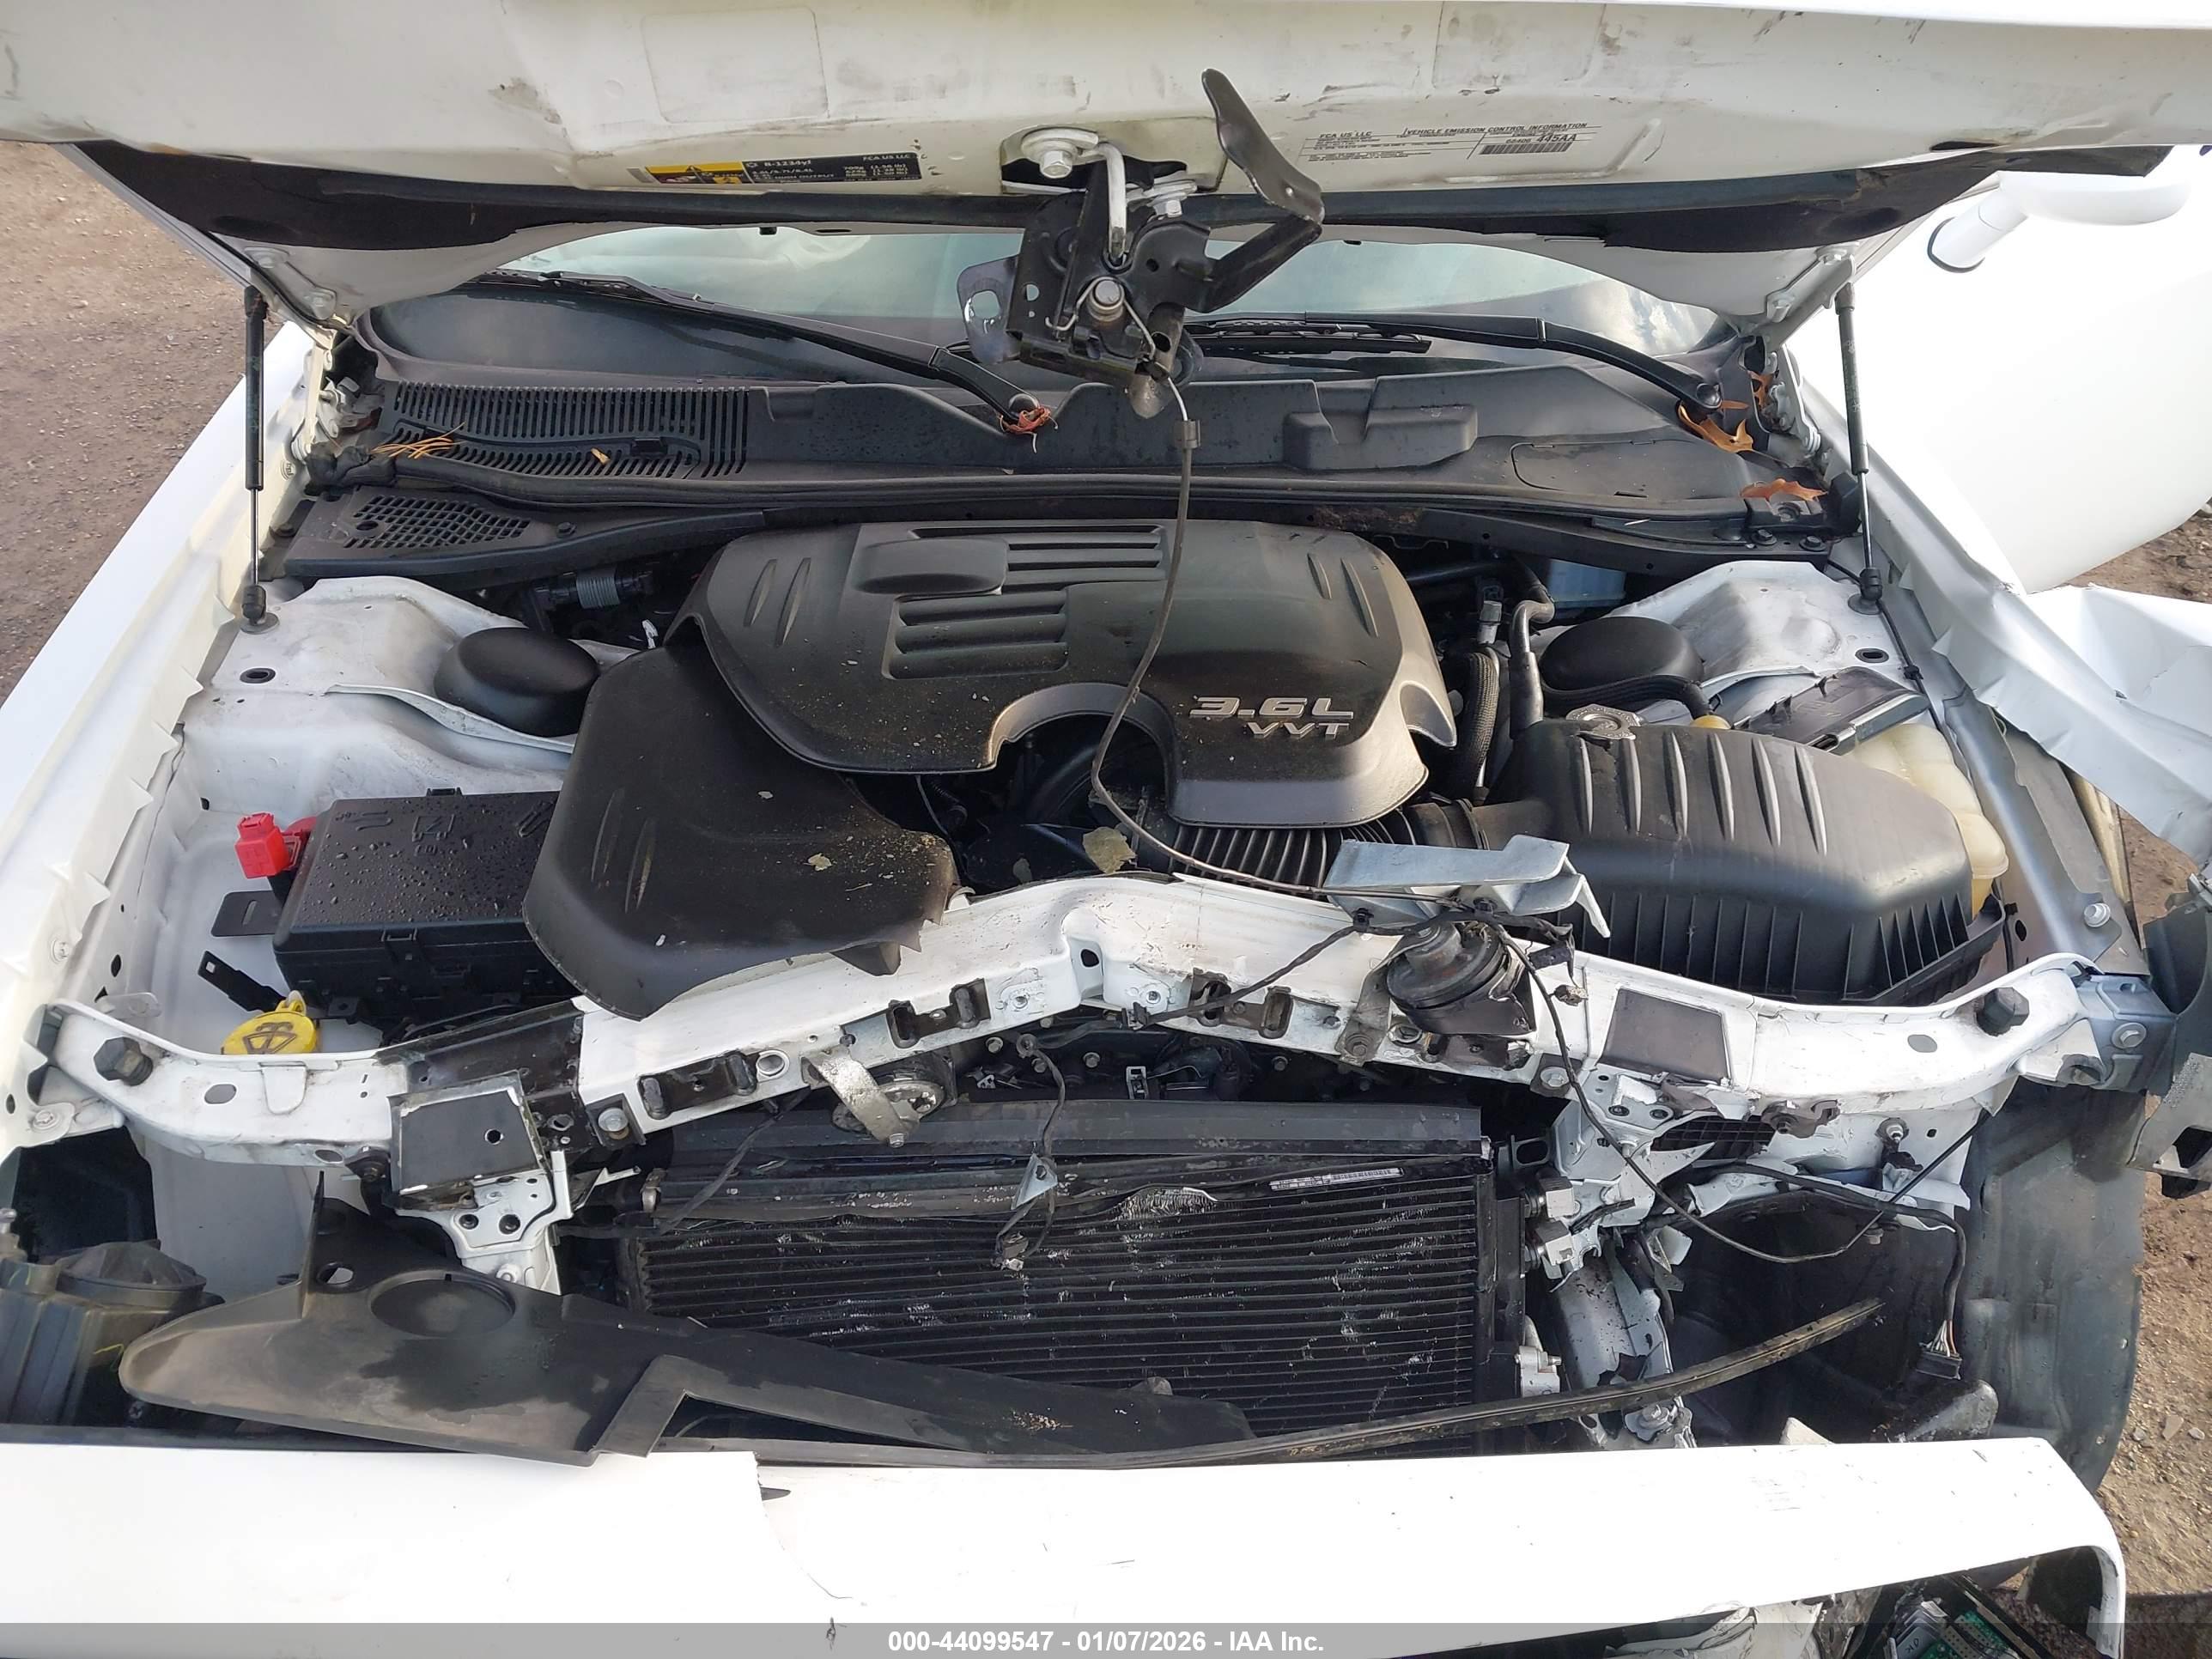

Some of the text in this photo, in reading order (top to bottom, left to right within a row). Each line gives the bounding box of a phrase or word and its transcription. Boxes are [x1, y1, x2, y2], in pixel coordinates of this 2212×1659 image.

[1528, 123, 1588, 131] INFORMATION
[1536, 133, 1577, 143] 445AA
[1189, 697, 1354, 719] 3.6L
[1247, 722, 1350, 738] VVT
